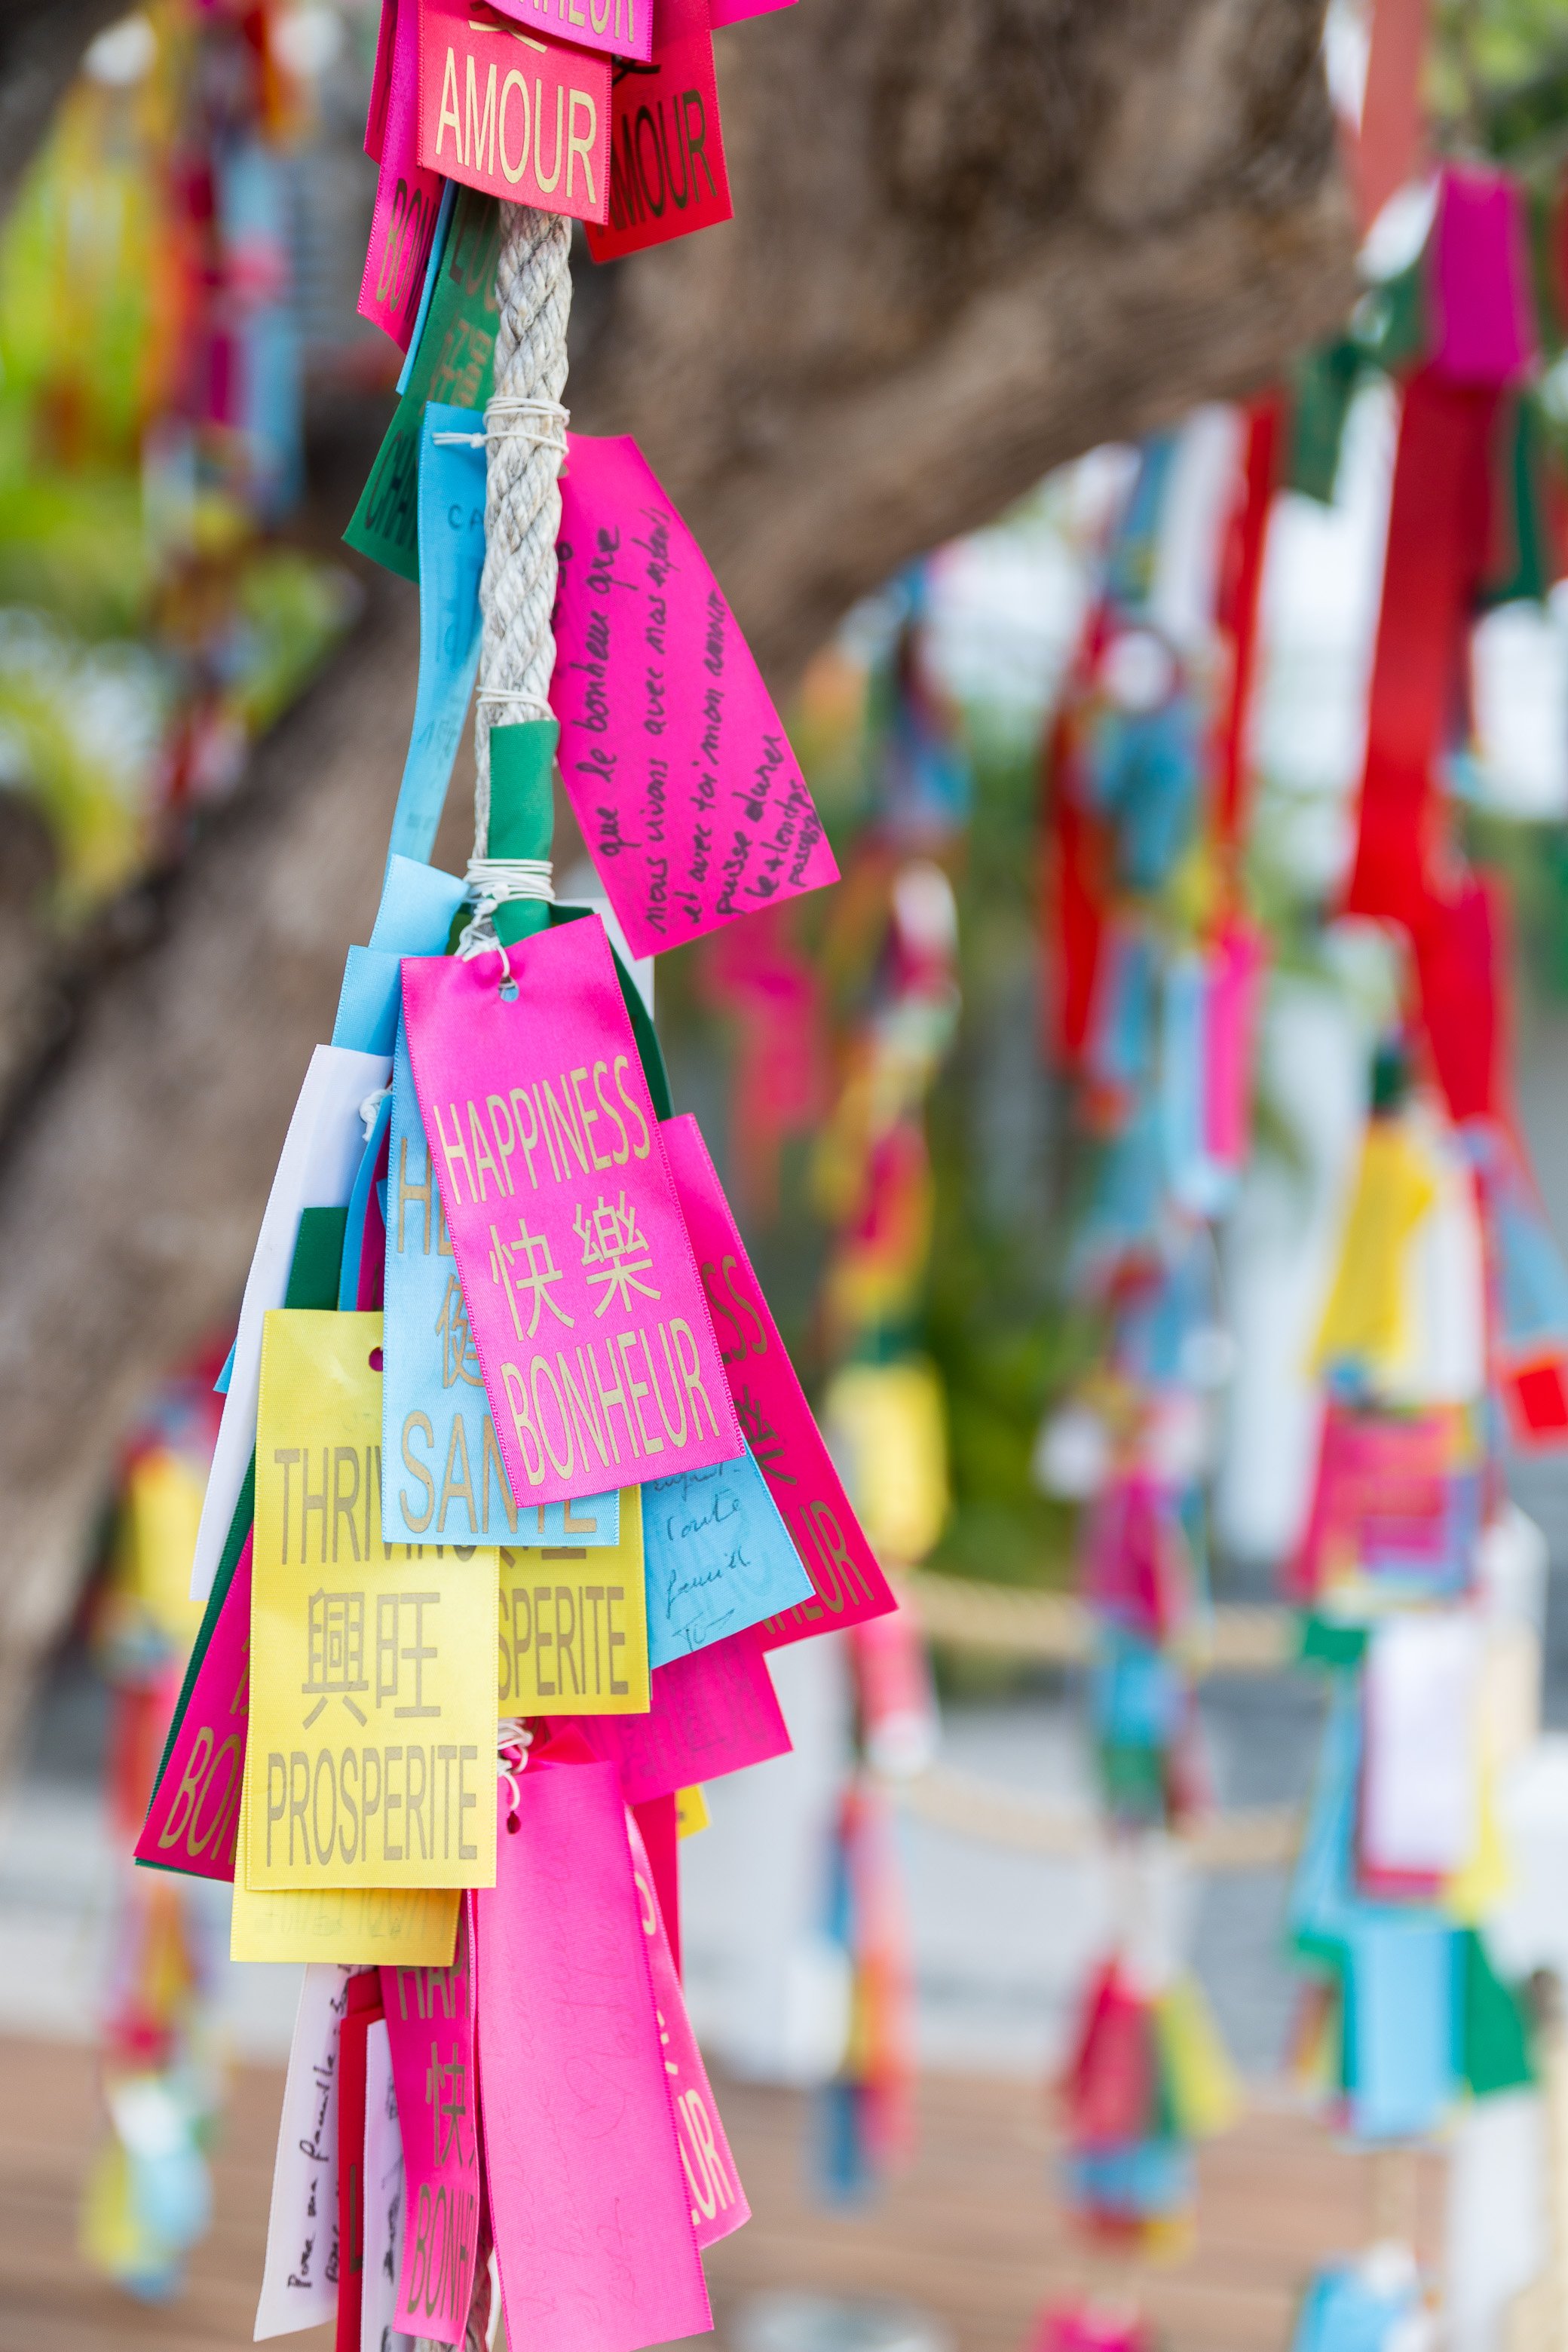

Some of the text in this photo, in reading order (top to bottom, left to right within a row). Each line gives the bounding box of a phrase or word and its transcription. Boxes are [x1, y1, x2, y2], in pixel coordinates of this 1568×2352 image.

[435, 46, 597, 204] AMOUR
[609, 88, 717, 231] MOUR
[575, 748, 617, 782] le
[644, 667, 666, 735] avec
[700, 688, 724, 766] mon
[599, 807, 642, 856] que
[689, 822, 712, 882] avec
[433, 1055, 651, 1205] HAPPINESS
[488, 1189, 662, 1341] 快樂
[500, 1317, 720, 1487] BONHEUR
[302, 1587, 442, 1730] 興旺
[266, 1744, 478, 1867] PROSPERITE
